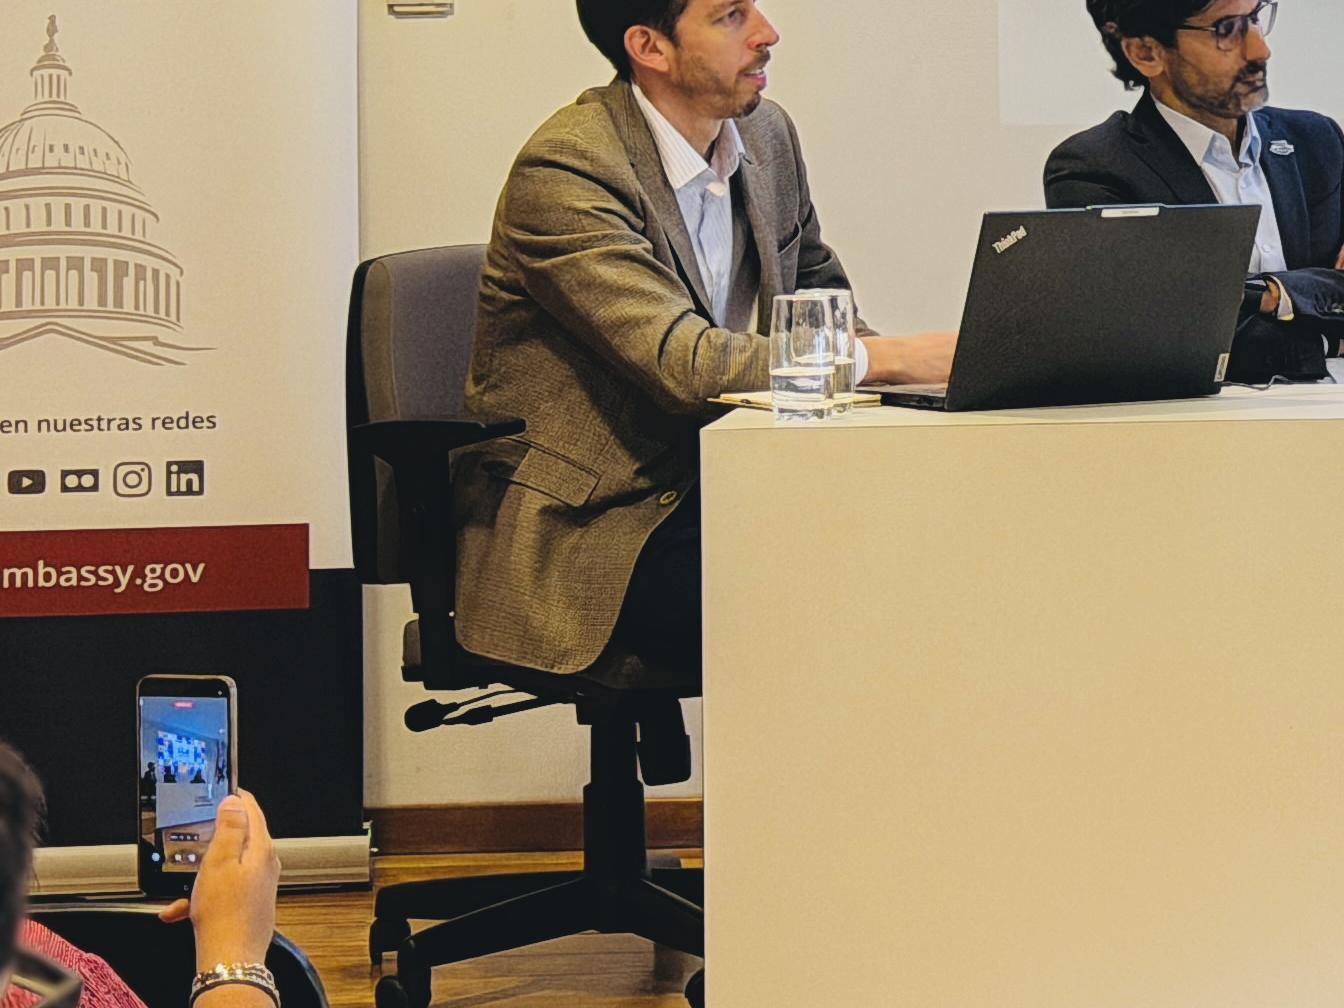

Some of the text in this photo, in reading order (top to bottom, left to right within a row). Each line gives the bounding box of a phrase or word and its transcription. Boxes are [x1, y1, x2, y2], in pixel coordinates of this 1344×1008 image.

[991, 225, 1028, 254] ThinkPad
[37, 415, 143, 432] nuestras
[151, 411, 217, 430] redes
[2, 560, 206, 592] mbassy.gov
